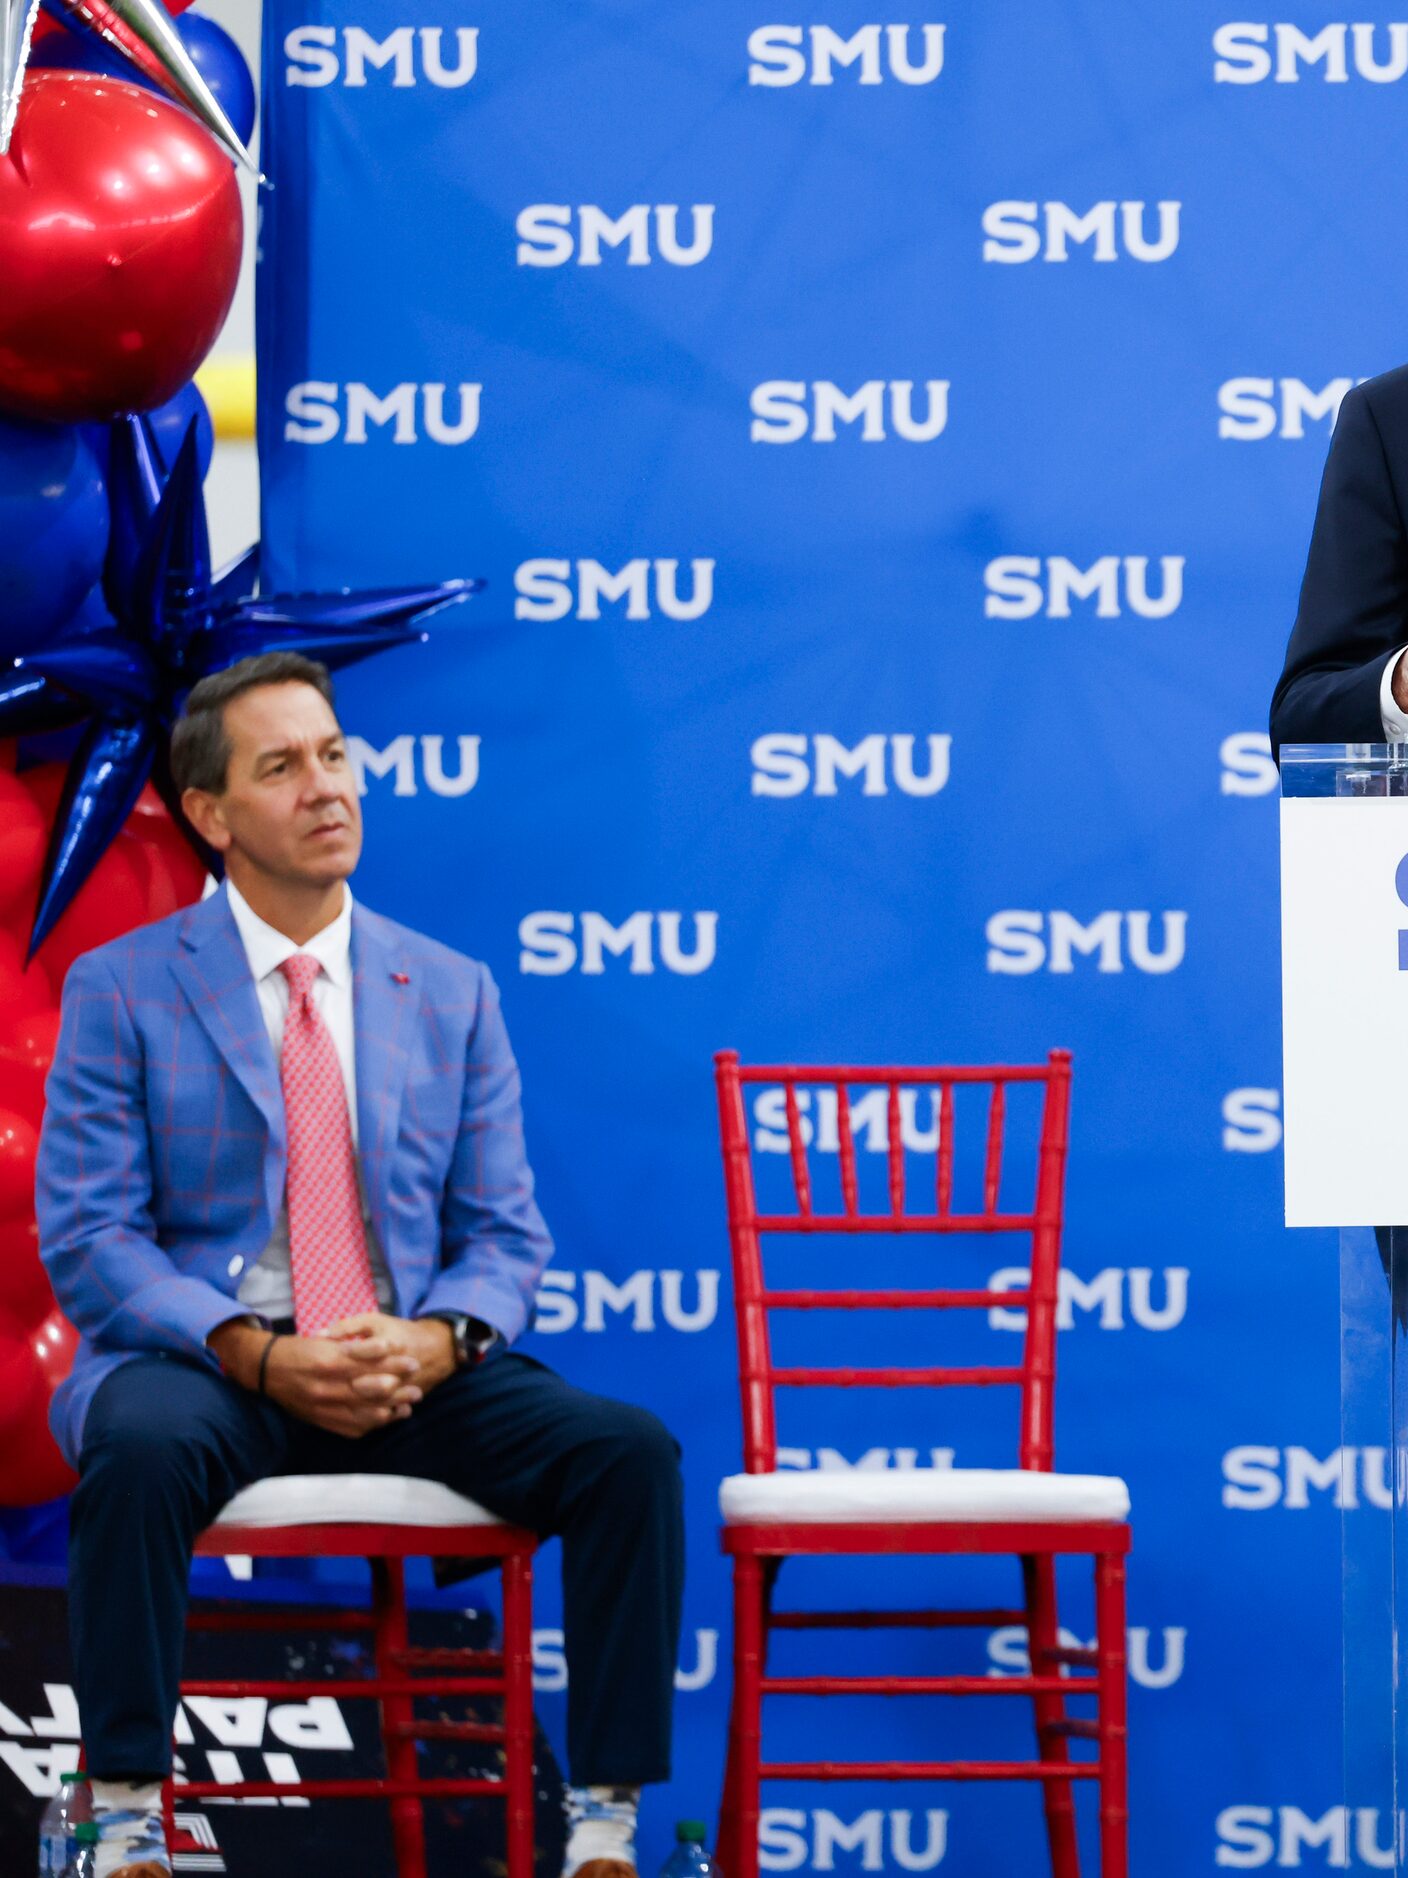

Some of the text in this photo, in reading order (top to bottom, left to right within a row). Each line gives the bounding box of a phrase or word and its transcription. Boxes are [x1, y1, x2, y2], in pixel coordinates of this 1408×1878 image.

[285, 26, 479, 88] SMU
[748, 24, 945, 86] SMU
[517, 205, 714, 266] SMU
[983, 201, 1181, 263] SMU
[286, 382, 482, 444] SMU
[751, 380, 949, 443] SMU
[1218, 377, 1352, 441] SM
[515, 559, 715, 620] SMU
[985, 556, 1184, 618] SMU
[342, 734, 481, 797] MU
[751, 734, 951, 797] SMU
[519, 912, 718, 975] SMU
[987, 911, 1187, 974] SMU
[535, 1268, 720, 1333] SMU
[758, 1808, 946, 1871] SMU
